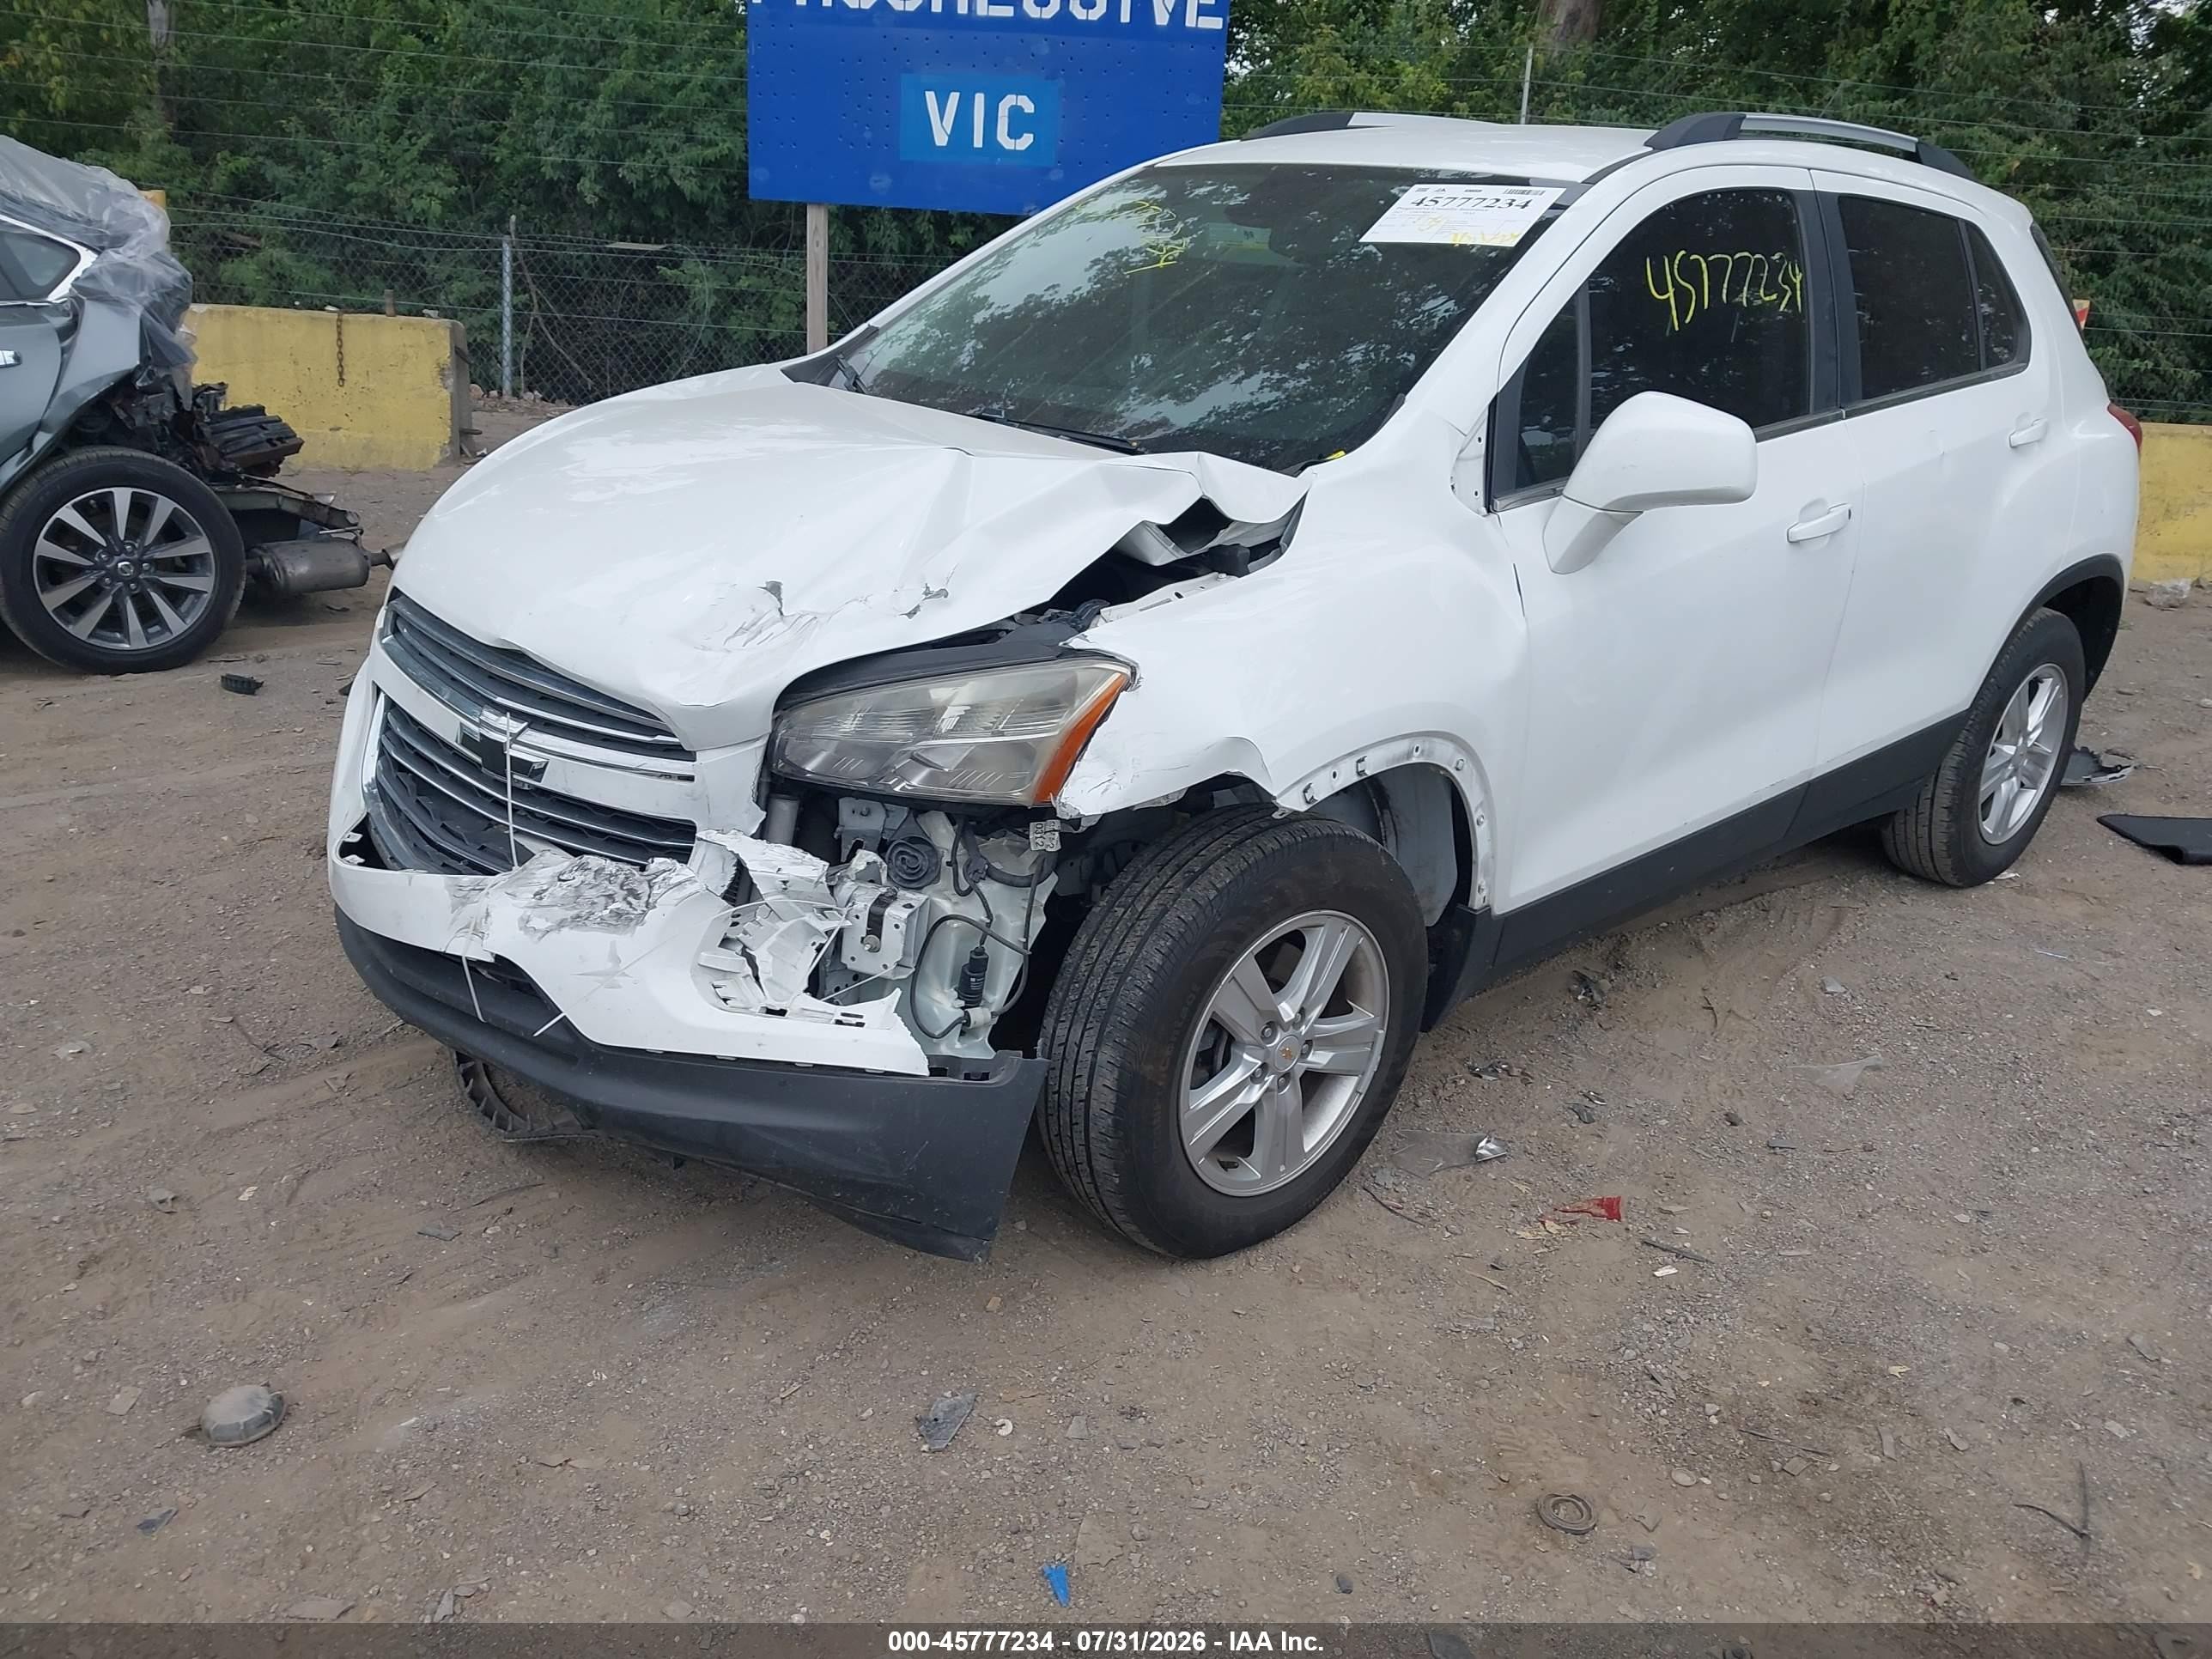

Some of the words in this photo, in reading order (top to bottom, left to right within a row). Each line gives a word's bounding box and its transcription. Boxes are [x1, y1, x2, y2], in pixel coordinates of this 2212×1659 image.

[925, 91, 1035, 150] VIC
[1411, 196, 1534, 210] 45777234
[1645, 250, 1803, 331] 45777234
